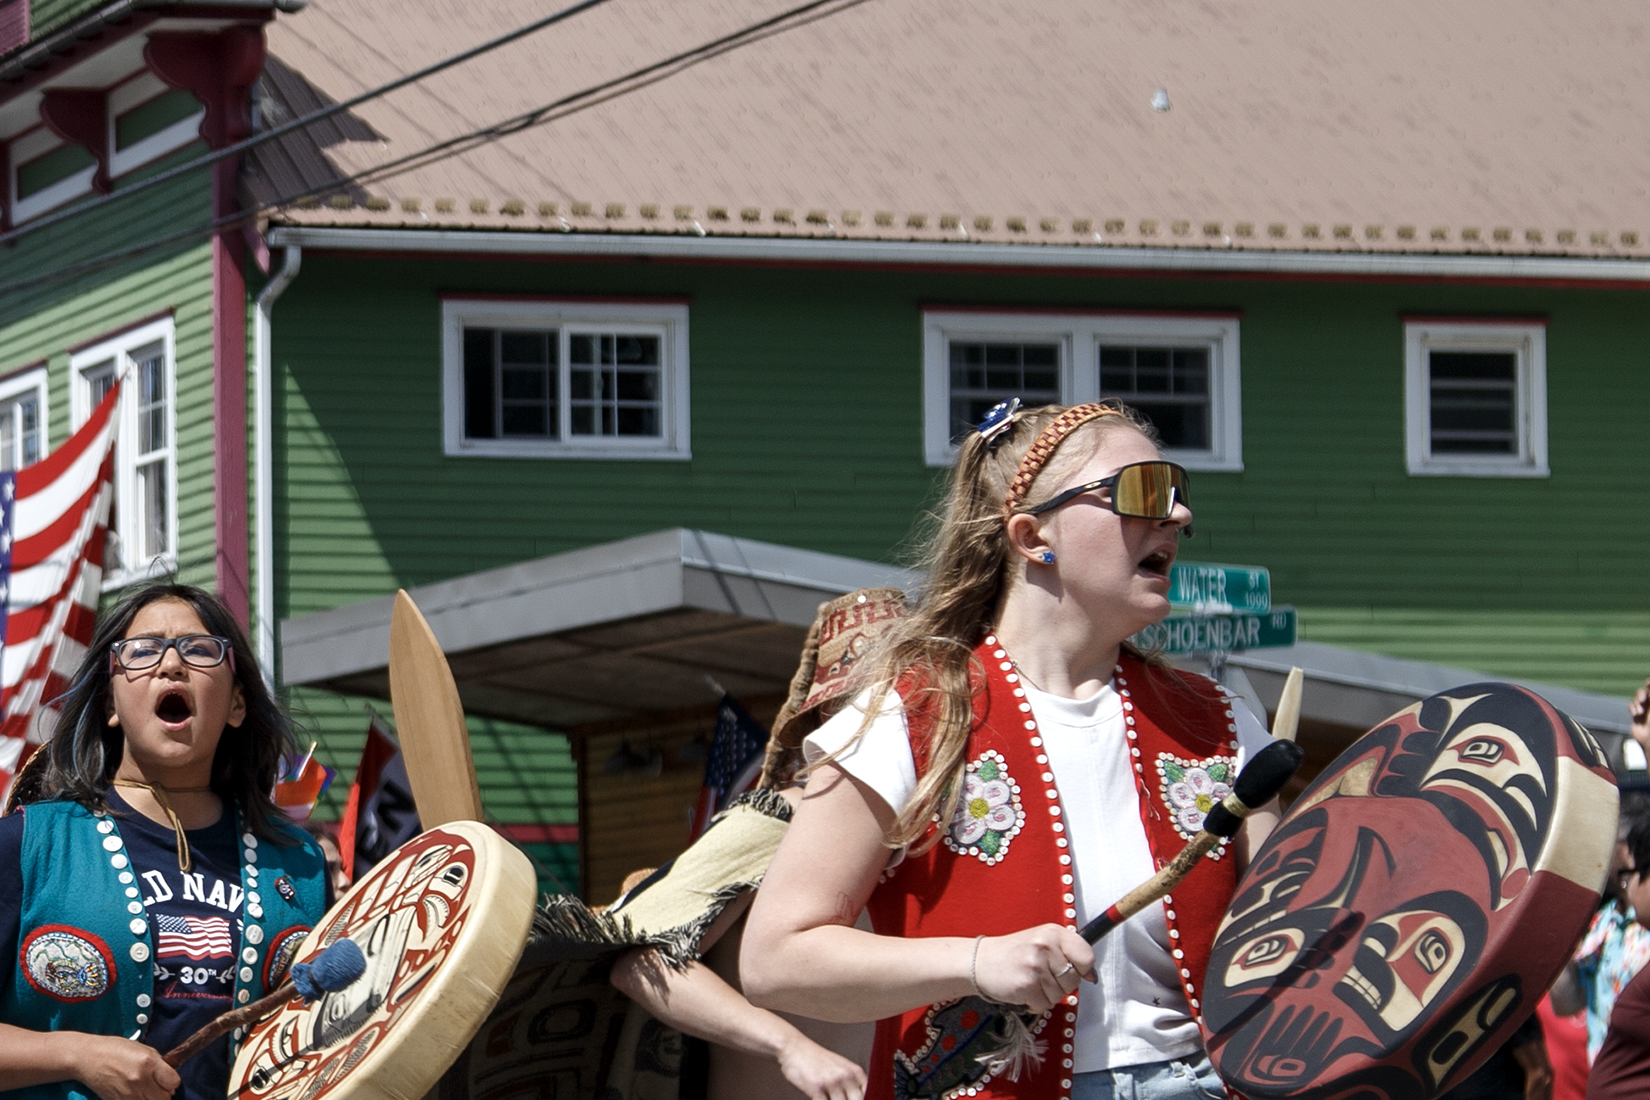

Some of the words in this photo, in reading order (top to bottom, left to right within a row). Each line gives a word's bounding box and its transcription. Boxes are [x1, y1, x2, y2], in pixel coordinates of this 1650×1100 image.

[1177, 566, 1228, 604] WATER
[1249, 571, 1261, 590] ST
[1141, 617, 1261, 650] SCHOENBAR
[1272, 614, 1288, 629] RD
[179, 965, 218, 986] 30TH
